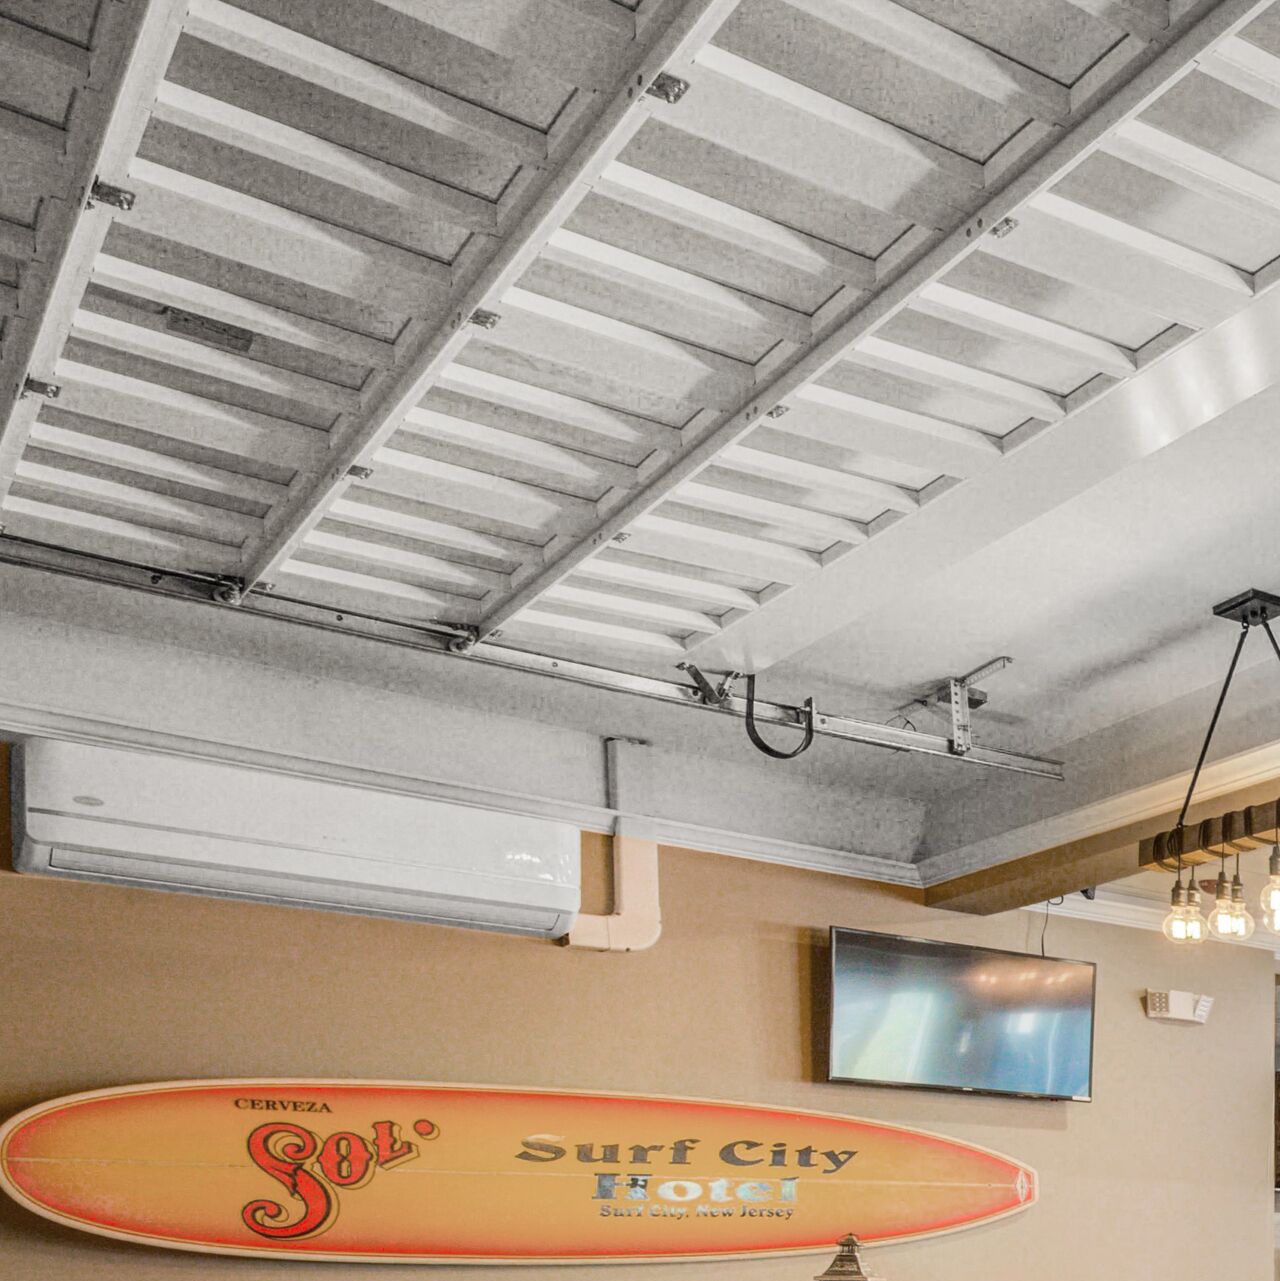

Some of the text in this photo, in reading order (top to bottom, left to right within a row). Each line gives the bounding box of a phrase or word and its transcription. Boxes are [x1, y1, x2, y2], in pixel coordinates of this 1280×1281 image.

[234, 1098, 333, 1114] CERVEZA
[515, 1133, 858, 1174] Surf City
[592, 1172, 800, 1203] Hotel
[600, 1204, 644, 1218] Surf
[696, 1204, 735, 1218] New
[740, 1205, 795, 1221] Jersey
